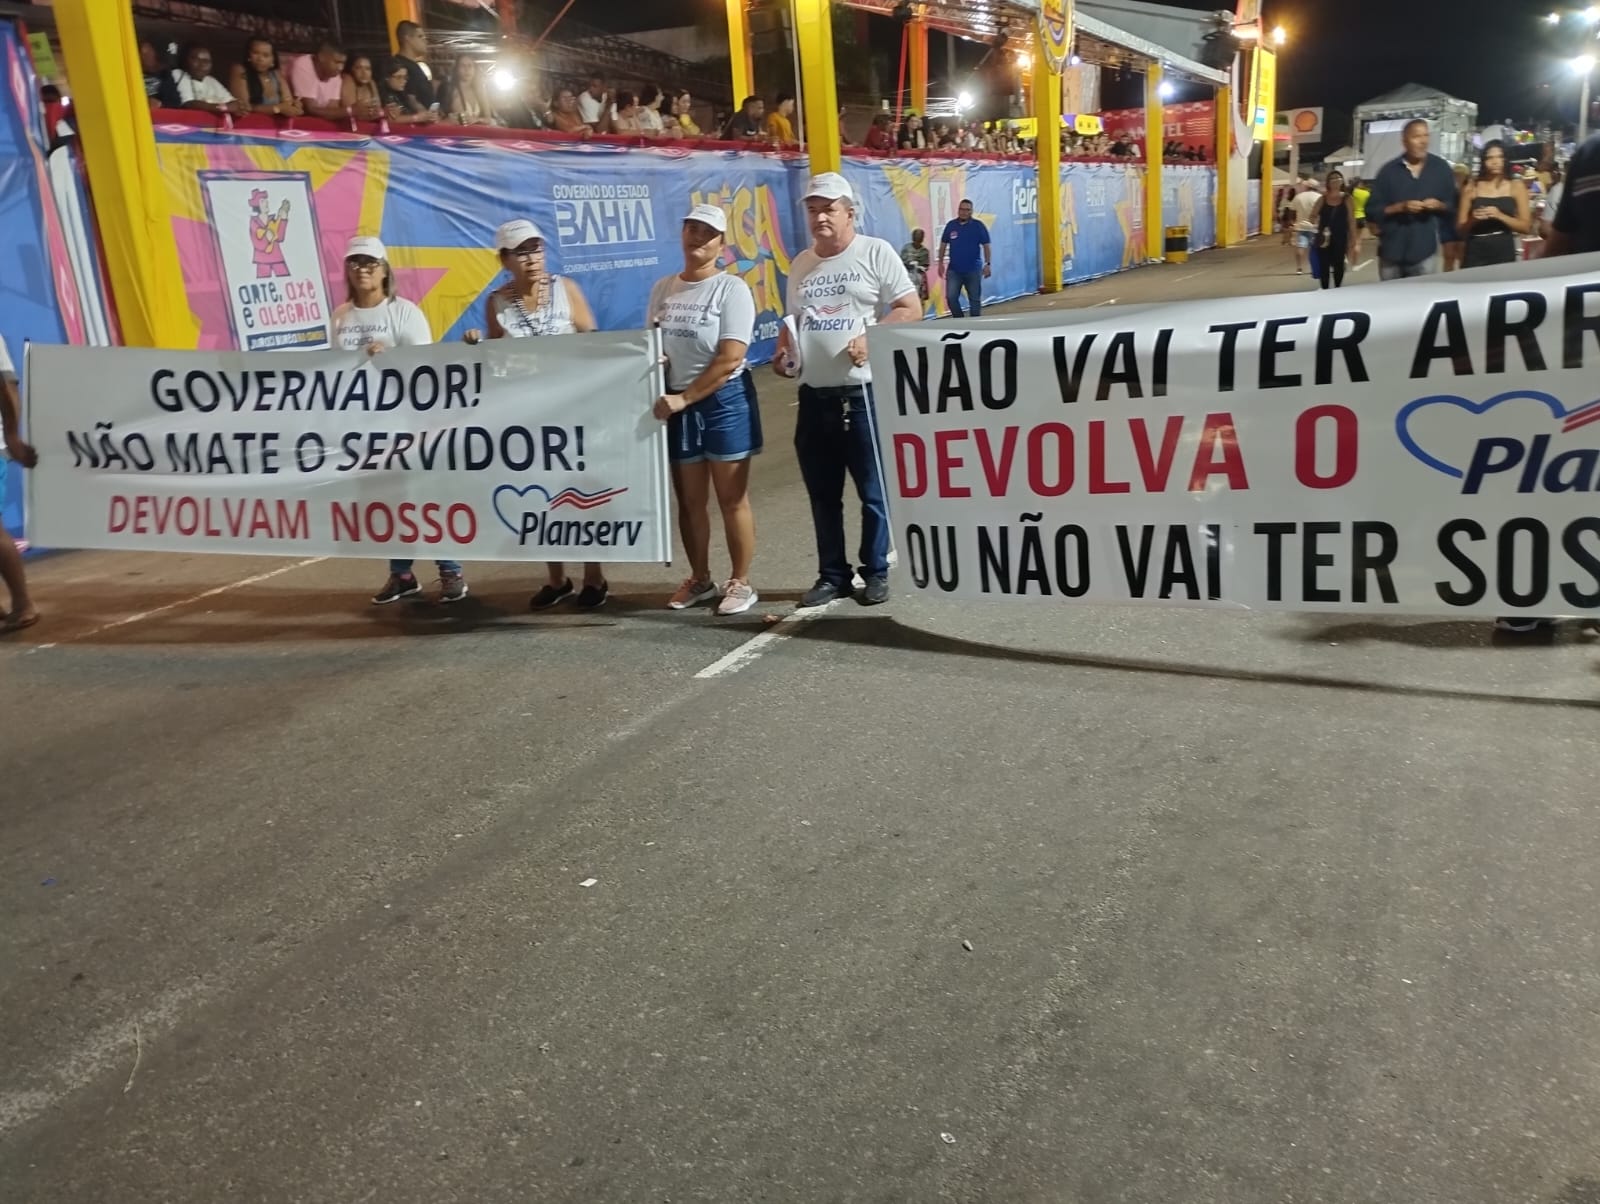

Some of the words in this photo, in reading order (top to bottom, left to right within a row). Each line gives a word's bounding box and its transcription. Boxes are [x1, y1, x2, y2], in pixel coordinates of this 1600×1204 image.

[553, 184, 600, 199] GOVERNO
[601, 184, 616, 199] DO
[616, 184, 650, 199] ESTADO
[555, 199, 656, 247] BAHIA
[804, 284, 846, 298] NOSSO
[151, 362, 482, 412] GOVERNADOR!
[893, 331, 1018, 416] NÃO
[1052, 328, 1174, 404] VAI
[1208, 311, 1371, 393] TER
[67, 421, 155, 471] NÃO
[164, 431, 280, 474] MATE
[295, 431, 325, 472] O
[336, 425, 586, 472] SERVIDOR!
[894, 411, 1250, 499] DEVOLVA
[1294, 404, 1359, 490] O
[1461, 434, 1600, 494] Pla
[108, 494, 310, 541] DEVOLVAM
[331, 501, 477, 544] NOSSO
[519, 511, 643, 546] Planserv
[905, 522, 960, 592] OU
[977, 511, 1091, 598] NÃO
[1116, 523, 1222, 601] VAI
[1253, 520, 1400, 604] TER
